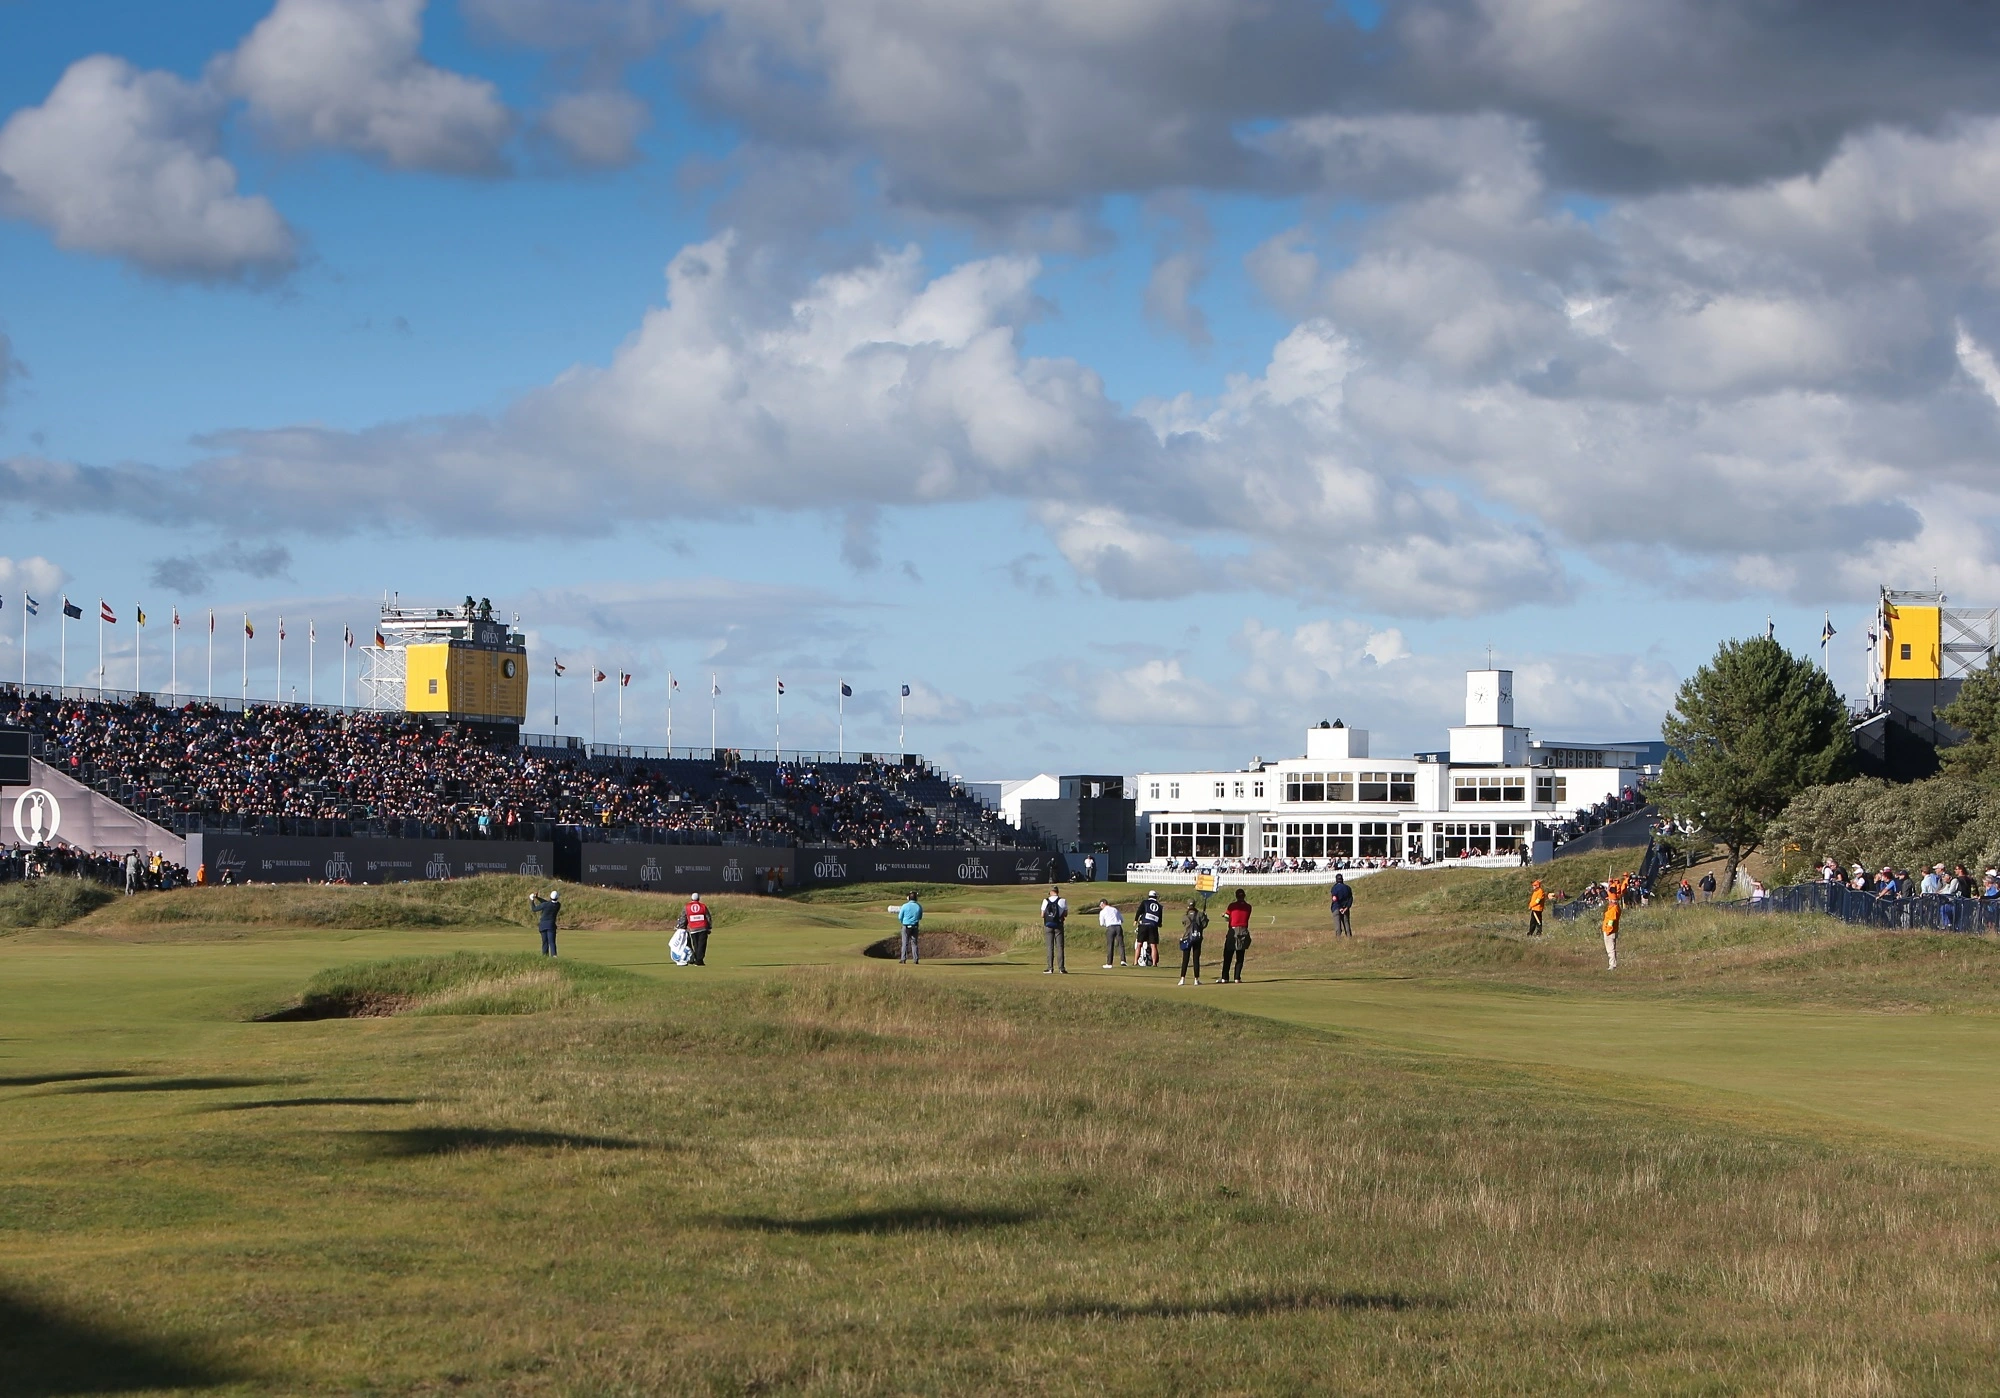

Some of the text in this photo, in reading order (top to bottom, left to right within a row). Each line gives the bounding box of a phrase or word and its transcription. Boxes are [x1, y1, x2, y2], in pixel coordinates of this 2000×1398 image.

[481, 630, 499, 644] OPEN
[1426, 754, 1437, 763] THE
[333, 852, 345, 861] THE
[433, 853, 444, 862] THE
[526, 854, 537, 864] THE
[646, 858, 656, 866] THE
[728, 858, 738, 867] THE
[824, 855, 838, 864] THE
[967, 857, 980, 866] THE
[325, 860, 353, 878] OPEN
[425, 860, 451, 879] OPEN
[519, 862, 544, 877] OPEN
[640, 864, 662, 882] OPEN
[722, 865, 743, 882] OPEN
[814, 861, 847, 878] OPEN
[957, 863, 989, 879] OPEN
